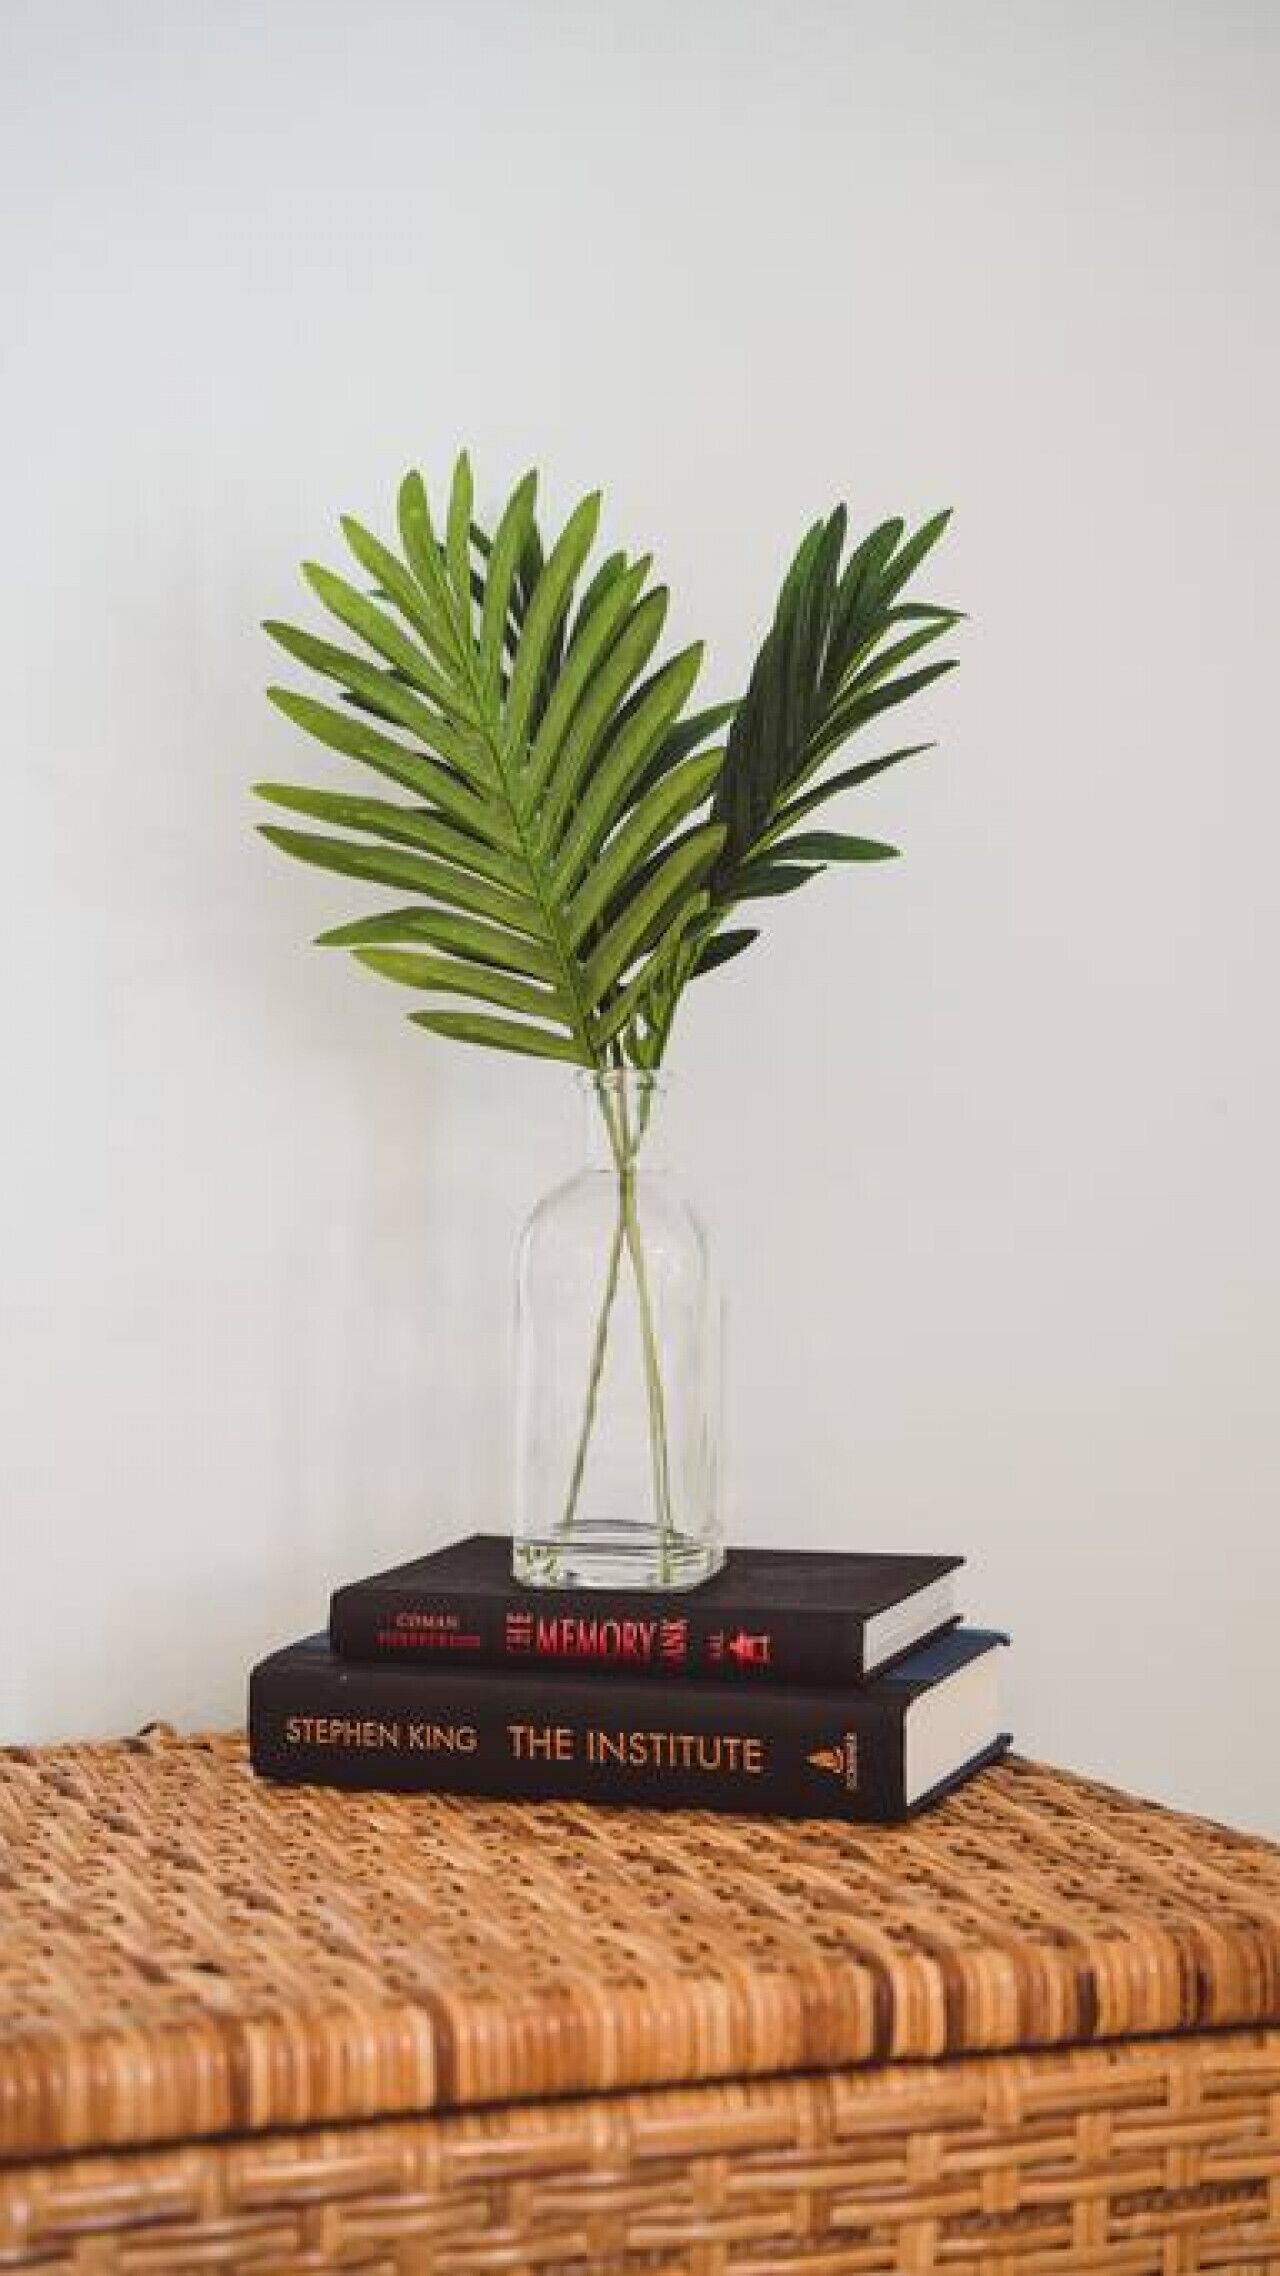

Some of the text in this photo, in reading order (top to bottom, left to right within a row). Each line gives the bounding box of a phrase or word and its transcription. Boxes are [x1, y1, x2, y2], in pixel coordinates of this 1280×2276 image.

[538, 1616, 657, 1654] MEMORY
[286, 1718, 478, 1751] STEPHEN KING
[507, 1725, 764, 1774] THE INSTITUTE
